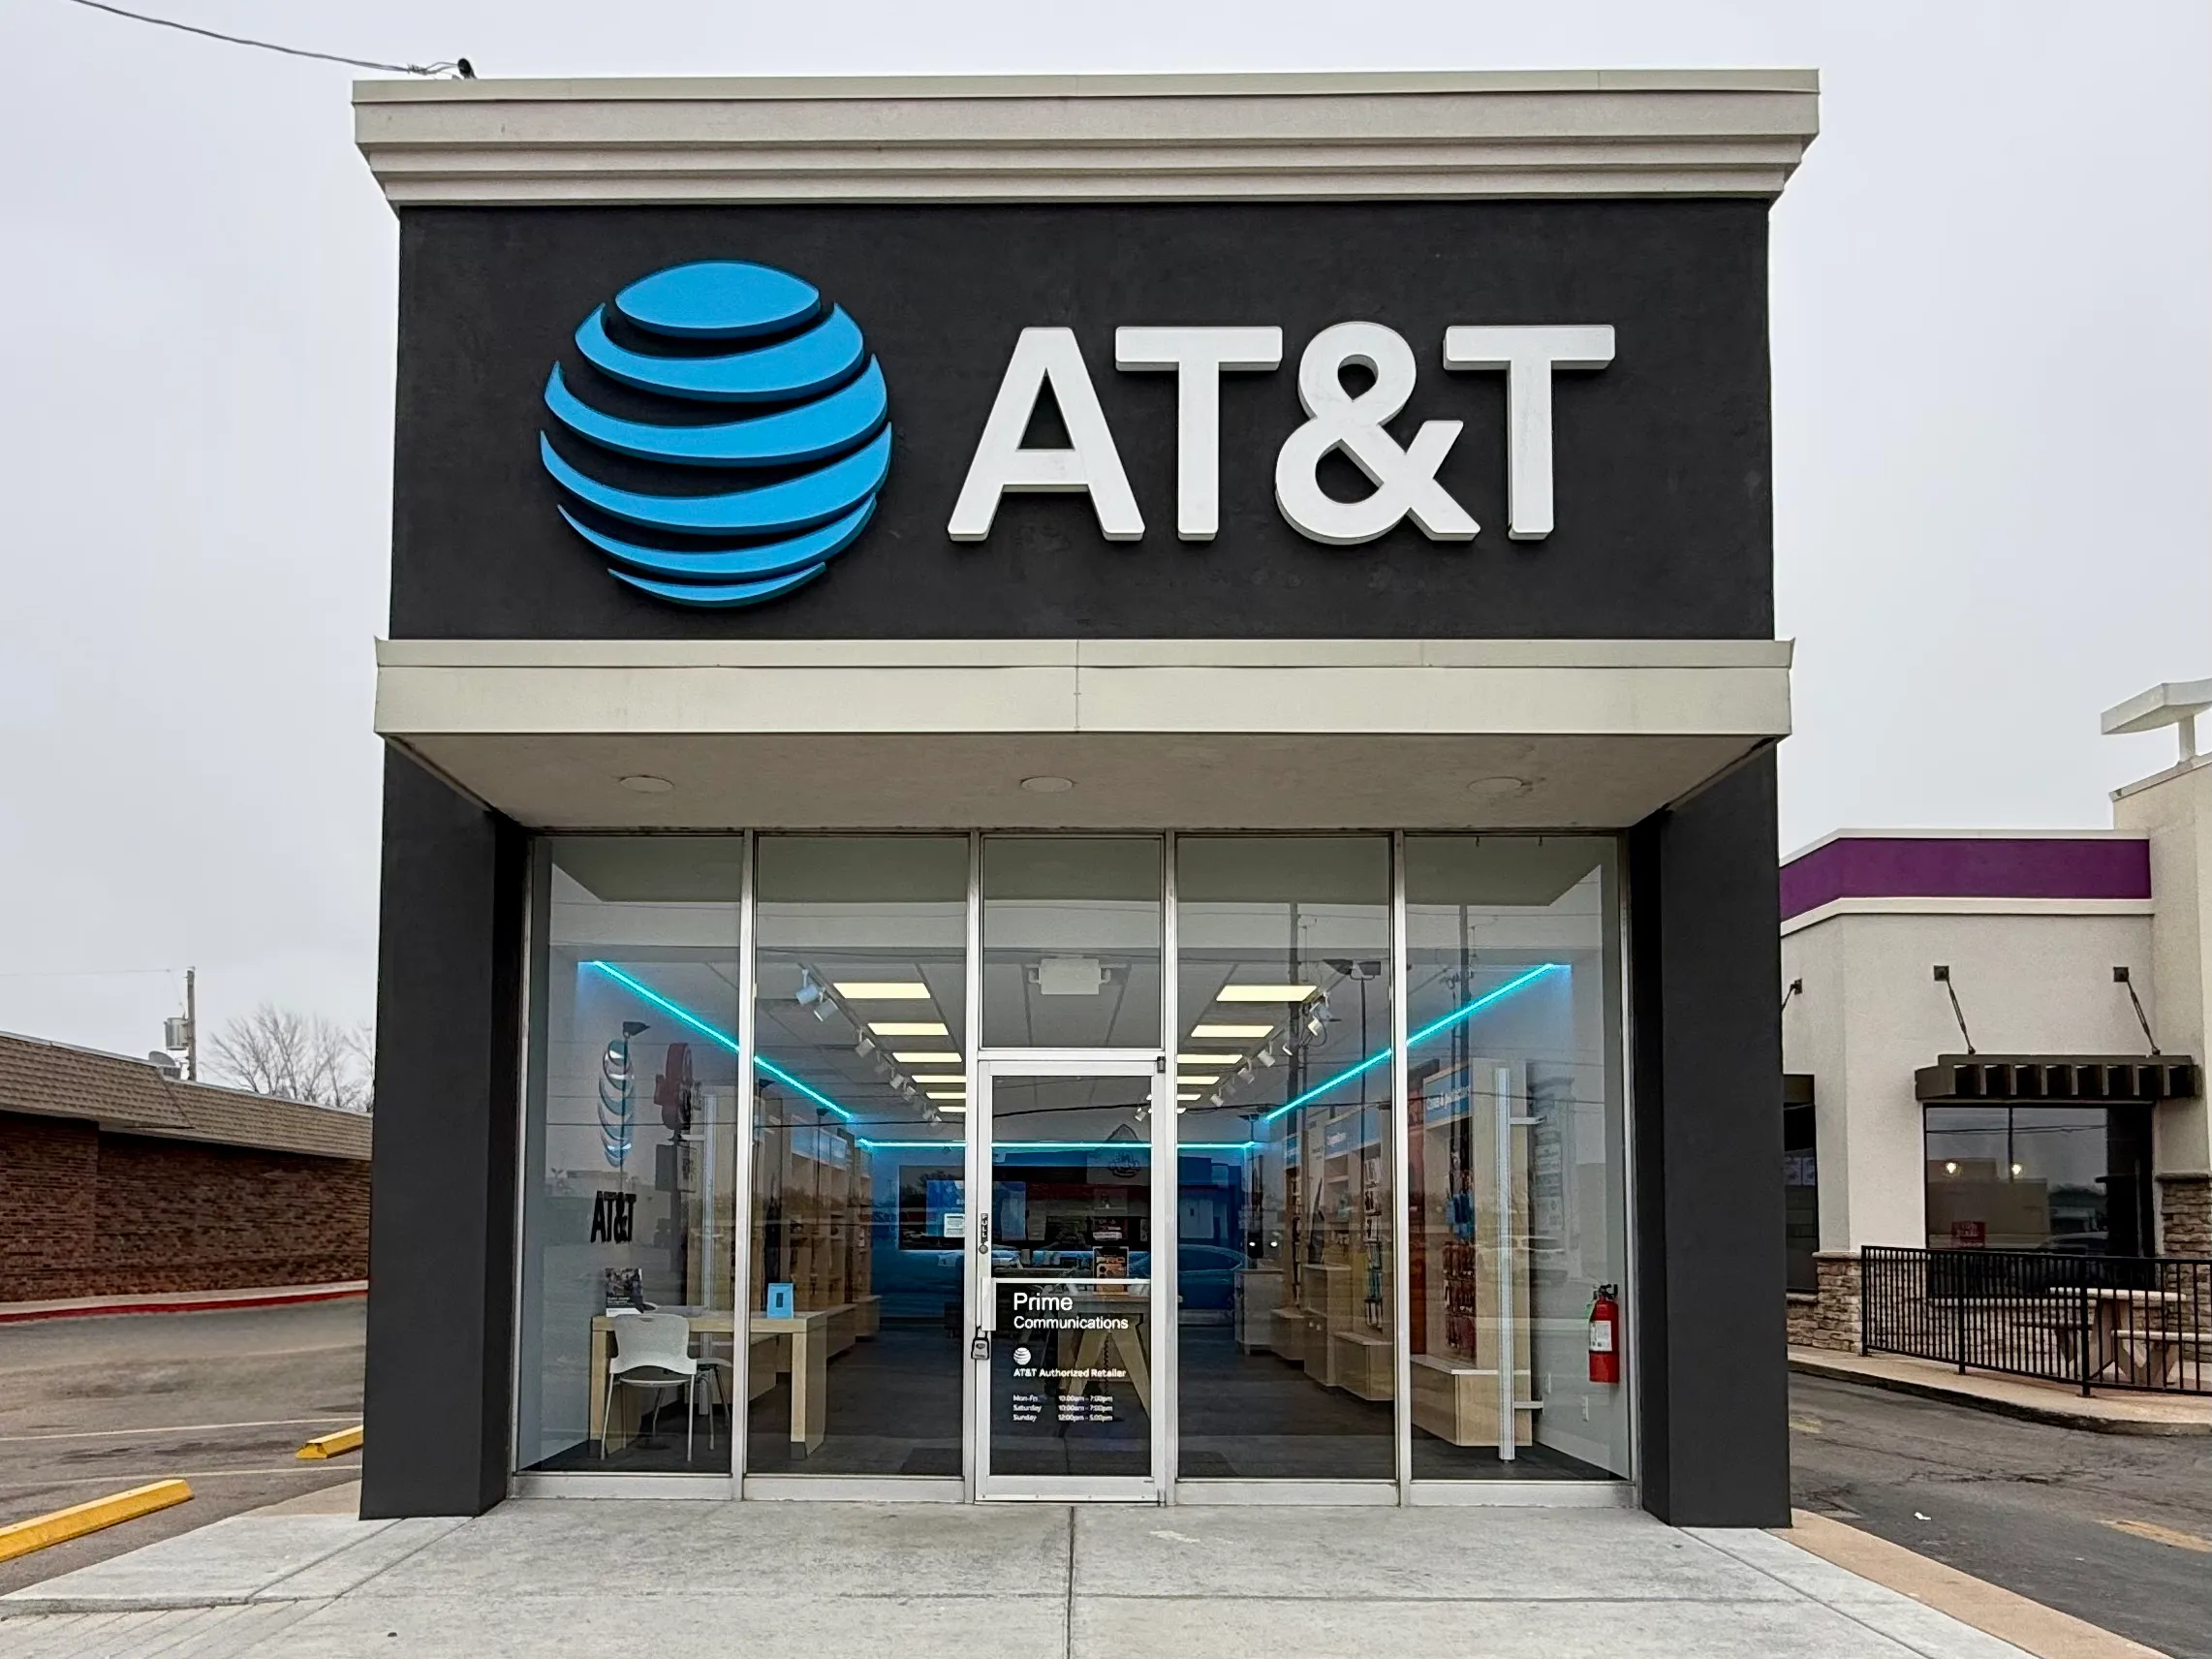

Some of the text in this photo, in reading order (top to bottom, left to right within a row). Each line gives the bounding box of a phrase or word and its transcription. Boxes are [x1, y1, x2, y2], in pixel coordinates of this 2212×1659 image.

[947, 321, 1615, 546] AT&T
[590, 1190, 637, 1244] AT&T
[1013, 1292, 1074, 1311] Prime
[1013, 1315, 1129, 1330] Communications
[1013, 1367, 1127, 1378] AT&T Authorized Retailer
[1013, 1404, 1043, 1413] Saturday
[1013, 1414, 1038, 1423] Sunday
